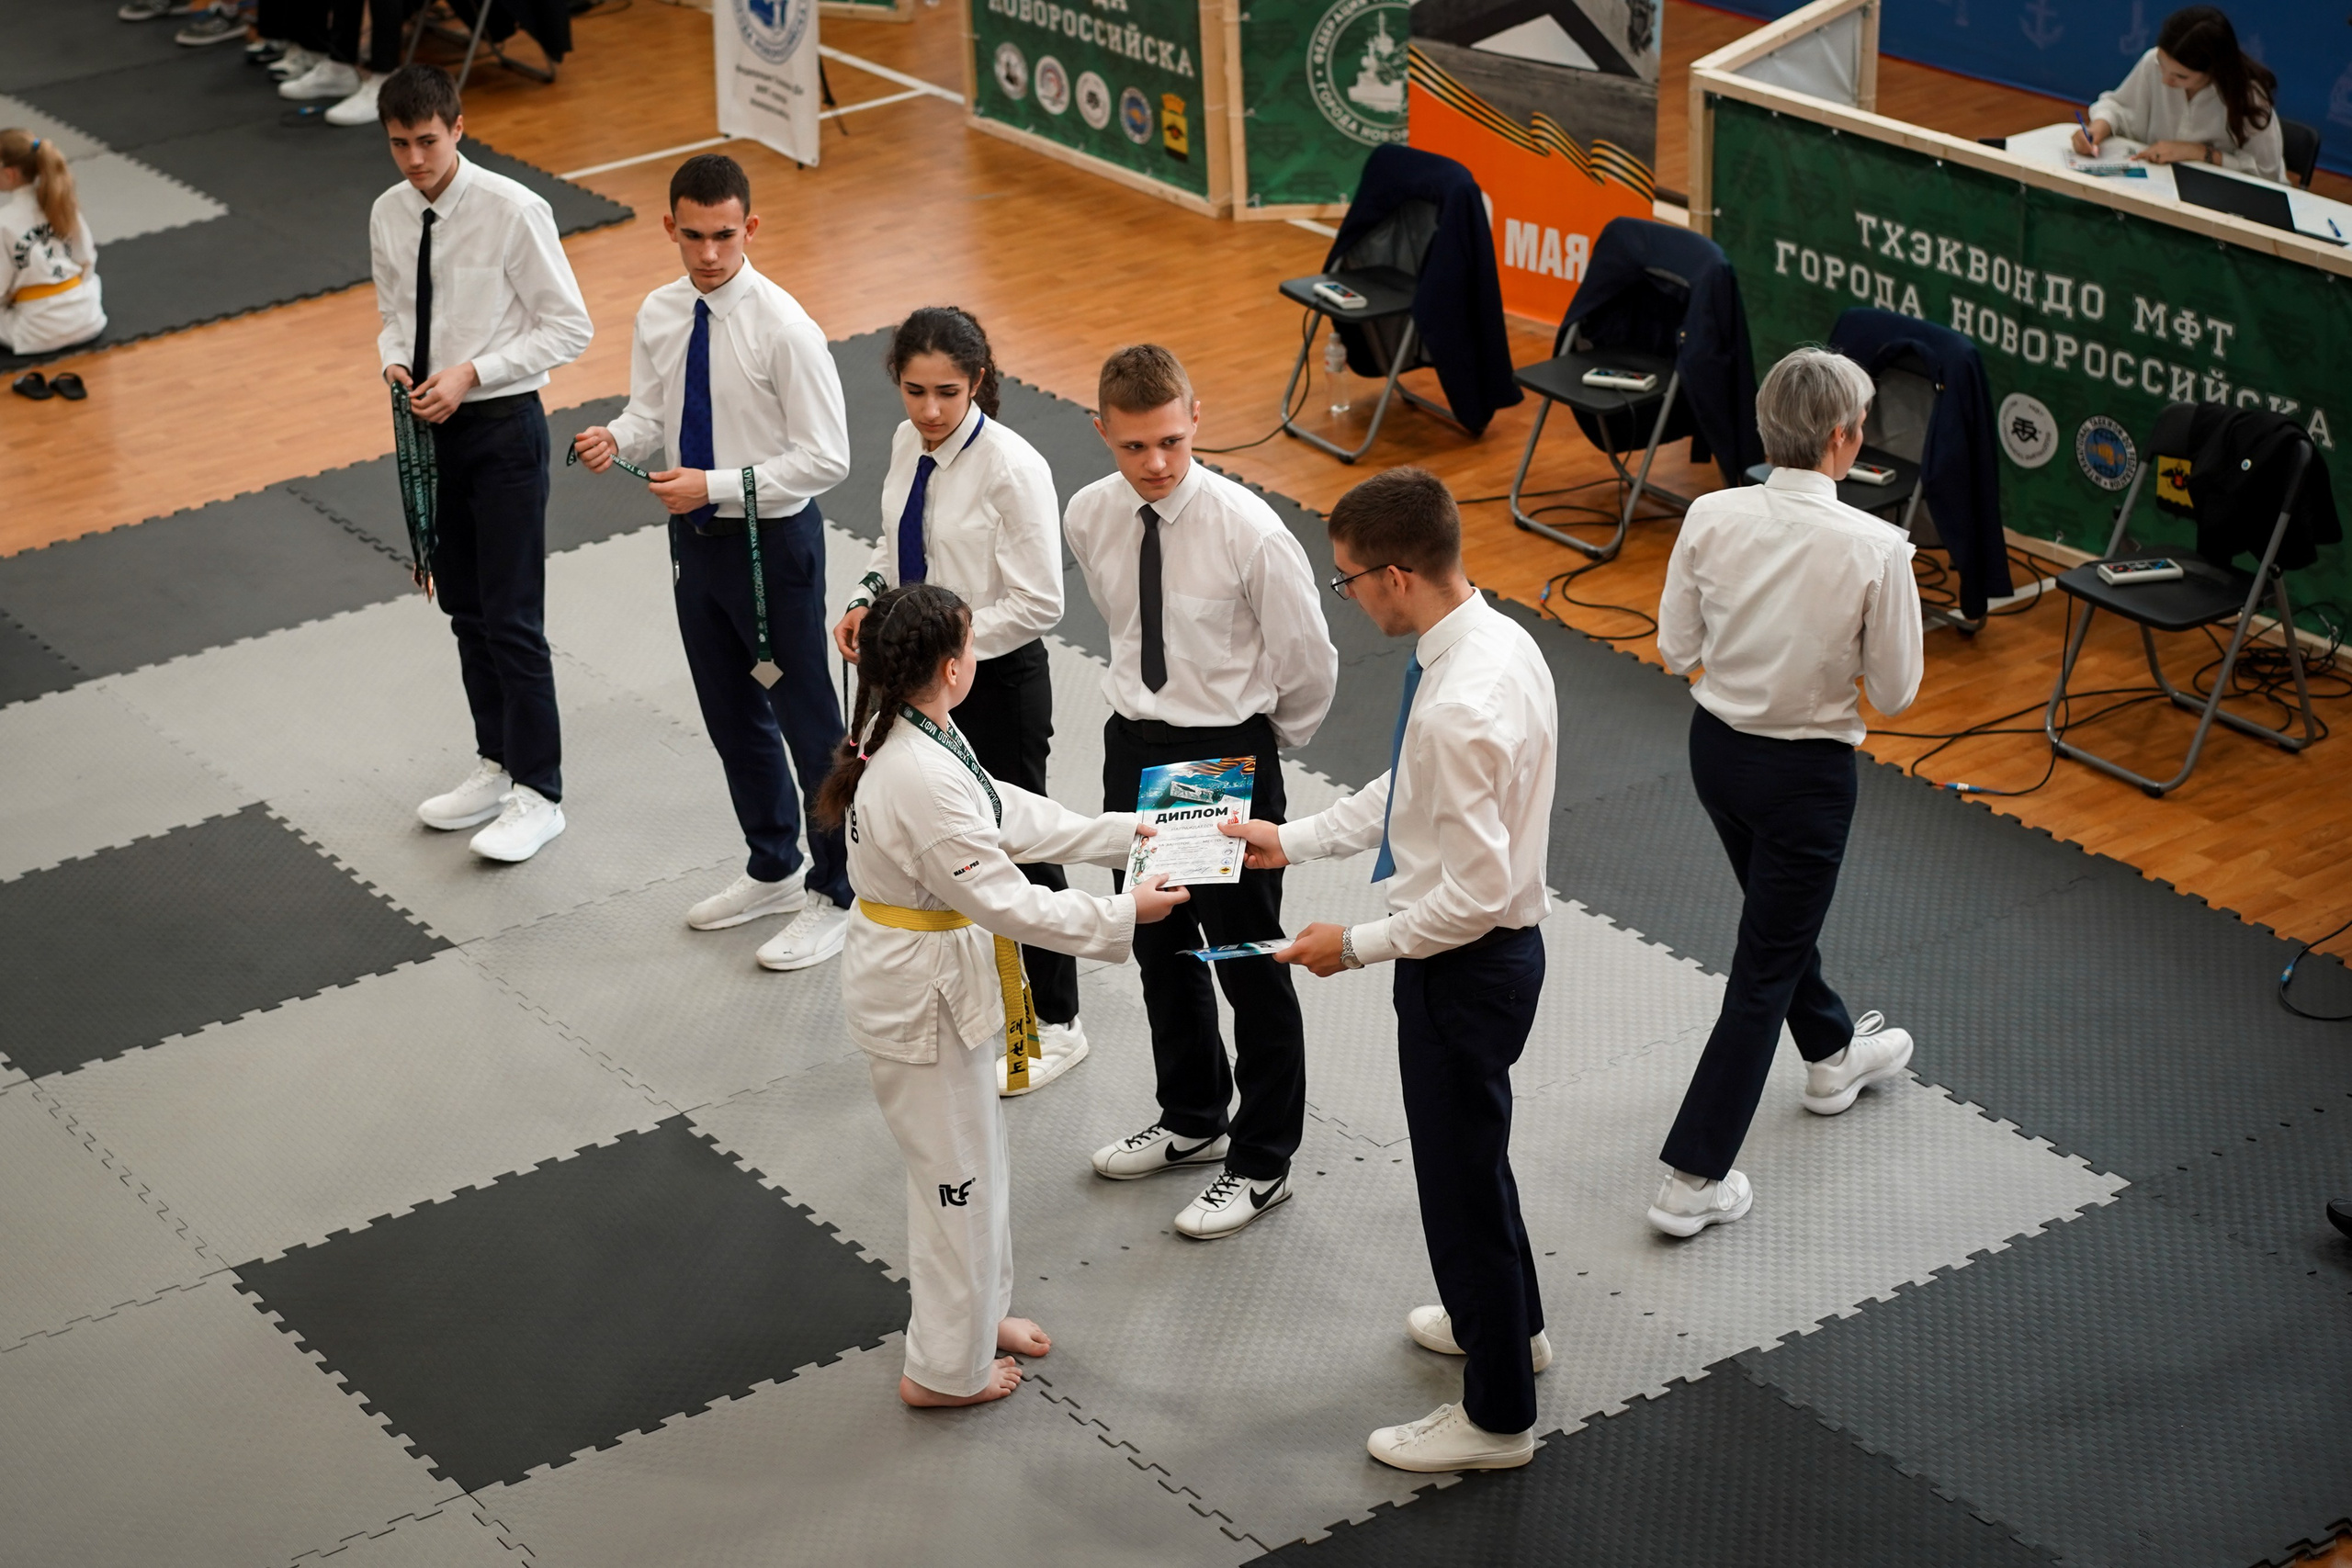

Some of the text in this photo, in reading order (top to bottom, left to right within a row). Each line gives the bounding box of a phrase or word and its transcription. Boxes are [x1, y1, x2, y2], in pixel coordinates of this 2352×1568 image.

[1503, 217, 1589, 284] МАЯ
[1774, 239, 1925, 320] ГОРОДА
[1854, 210, 2235, 359] ТХЭКВОНДО МФТ
[743, 468, 754, 492] КУБОК
[919, 717, 938, 736] МФТ
[937, 731, 970, 766] ТХЭКВОНДО
[971, 761, 979, 774] ПО
[1155, 807, 1228, 825] ДИПЛОМ
